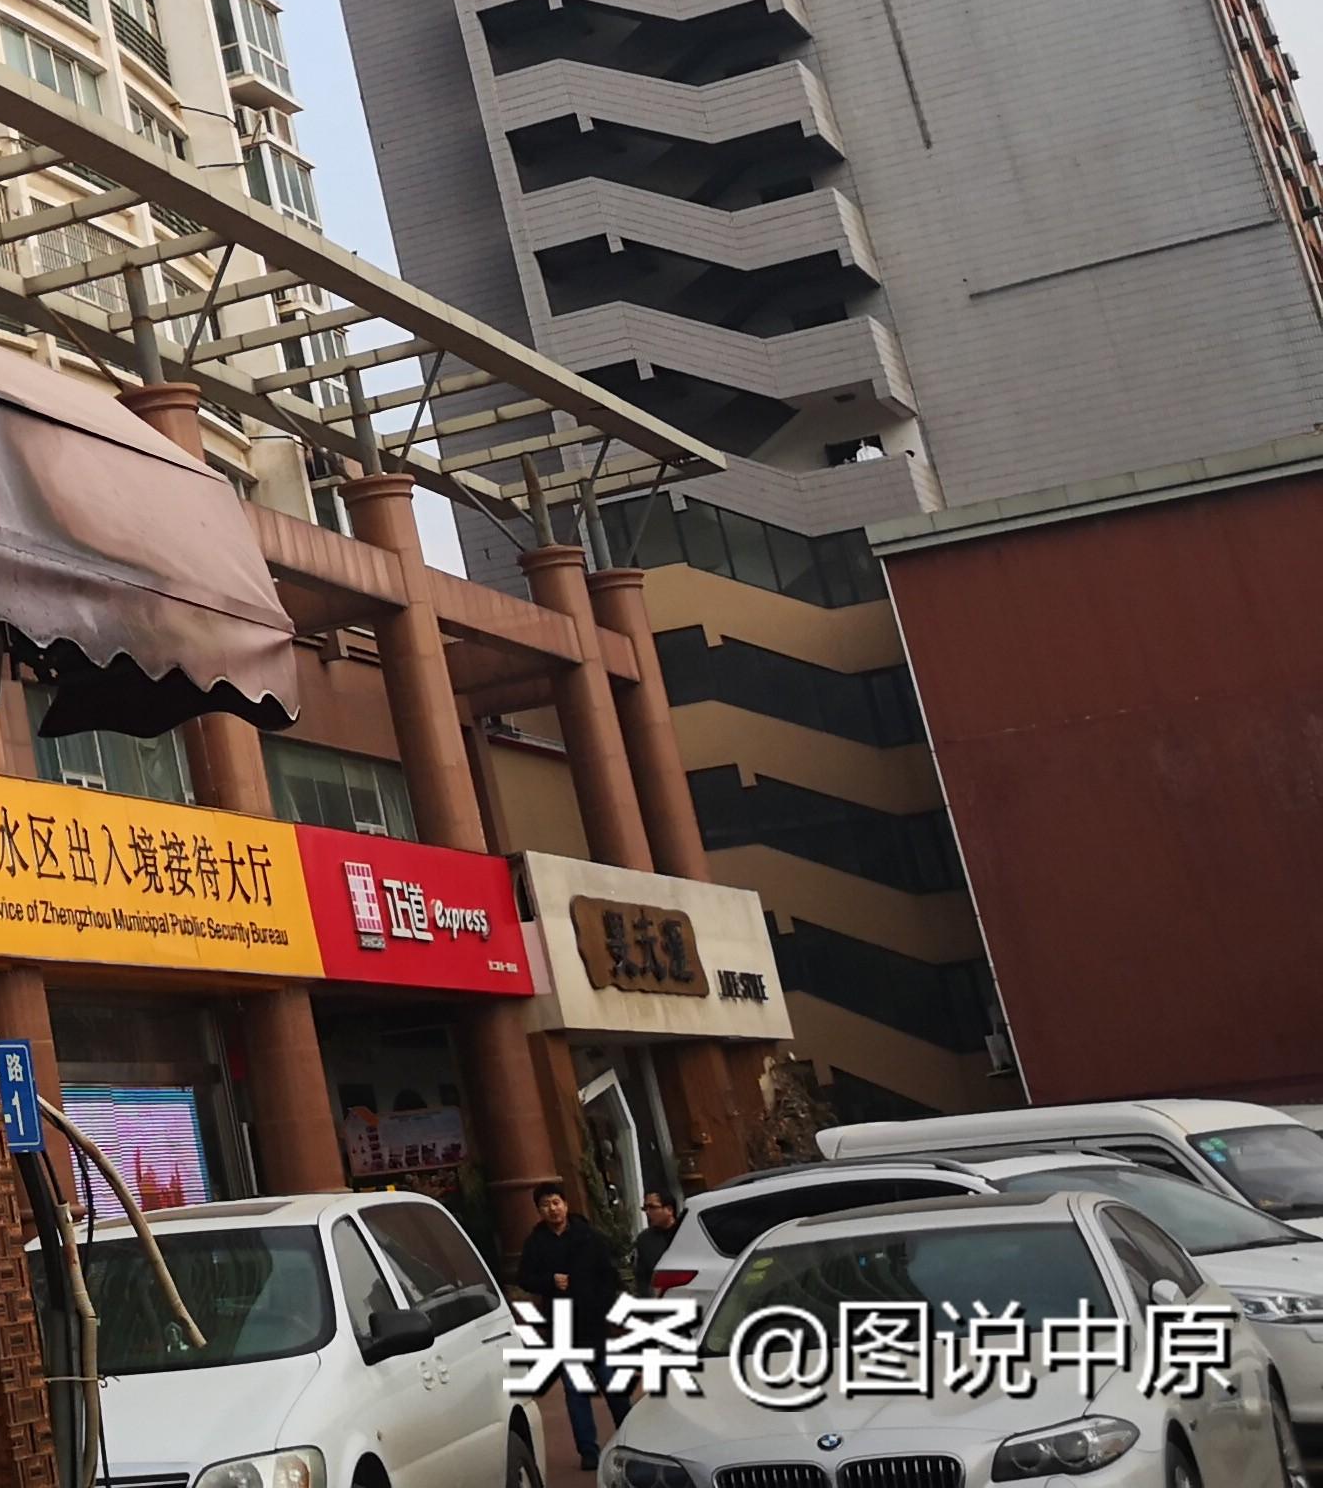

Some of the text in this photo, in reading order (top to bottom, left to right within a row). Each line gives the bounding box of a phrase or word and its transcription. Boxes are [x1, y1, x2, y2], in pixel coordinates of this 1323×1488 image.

[26, 899, 40, 923] of
[39, 899, 112, 933] Zhengzhou
[112, 908, 170, 938] Municipal
[169, 913, 206, 938] Public
[206, 917, 251, 949] Security
[249, 922, 289, 946] Bureau
[434, 899, 489, 940] express
[3, 1089, 25, 1137] -1
